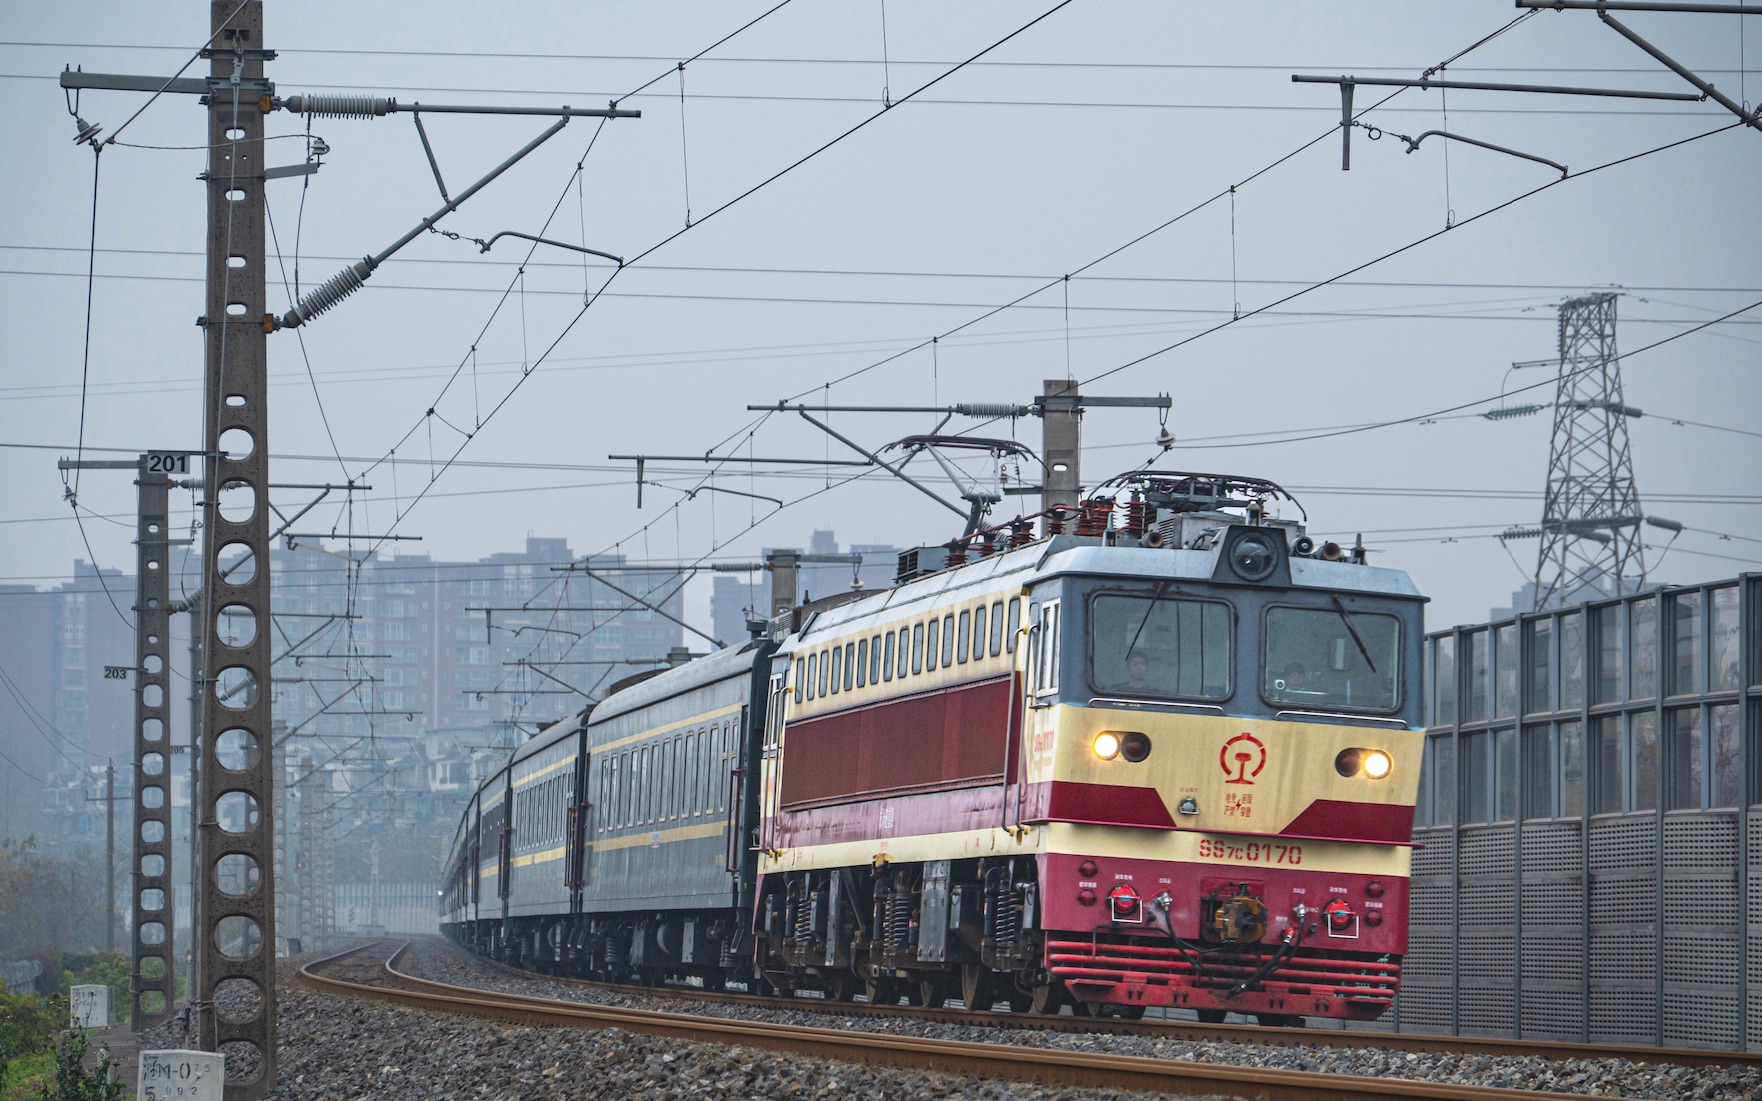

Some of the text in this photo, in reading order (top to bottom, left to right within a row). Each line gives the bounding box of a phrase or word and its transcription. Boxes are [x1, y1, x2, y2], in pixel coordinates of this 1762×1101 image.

[149, 455, 186, 472] 201
[104, 668, 127, 679] 203
[170, 746, 185, 754] 205
[1199, 839, 1303, 865] SS7C0170
